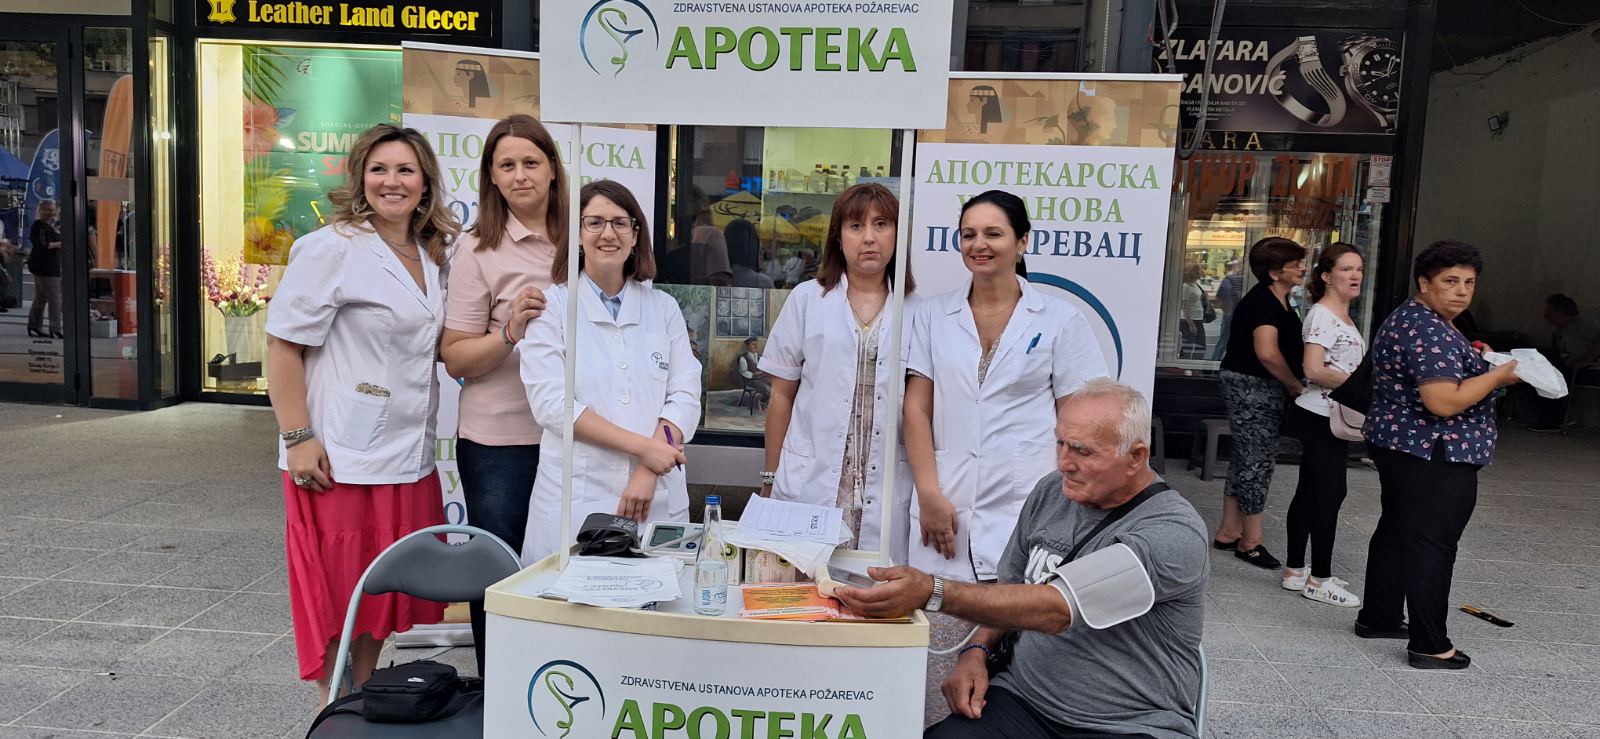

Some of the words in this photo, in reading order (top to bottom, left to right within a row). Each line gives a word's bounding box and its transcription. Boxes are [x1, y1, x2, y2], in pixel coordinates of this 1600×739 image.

[249, 1, 333, 24] Leather
[340, 3, 395, 27] Land
[401, 6, 479, 31] Glecer
[673, 3, 746, 13] ZDRAVSTVENA
[748, 3, 803, 13] USTANOVA
[804, 3, 852, 13] APOTEKA
[855, 1, 919, 13] POŽAREVAC
[665, 26, 917, 72] APOTEKA
[925, 160, 1160, 190] АПОТЕКАРСКА
[1273, 153, 1355, 198] ZLATA
[620, 675, 696, 693] ZDRAVSTVENA
[698, 683, 755, 697] USTANOVA
[757, 687, 807, 700] APOTEKA
[809, 688, 874, 701] POŽAREVAC
[611, 698, 868, 739] APOTEKA
